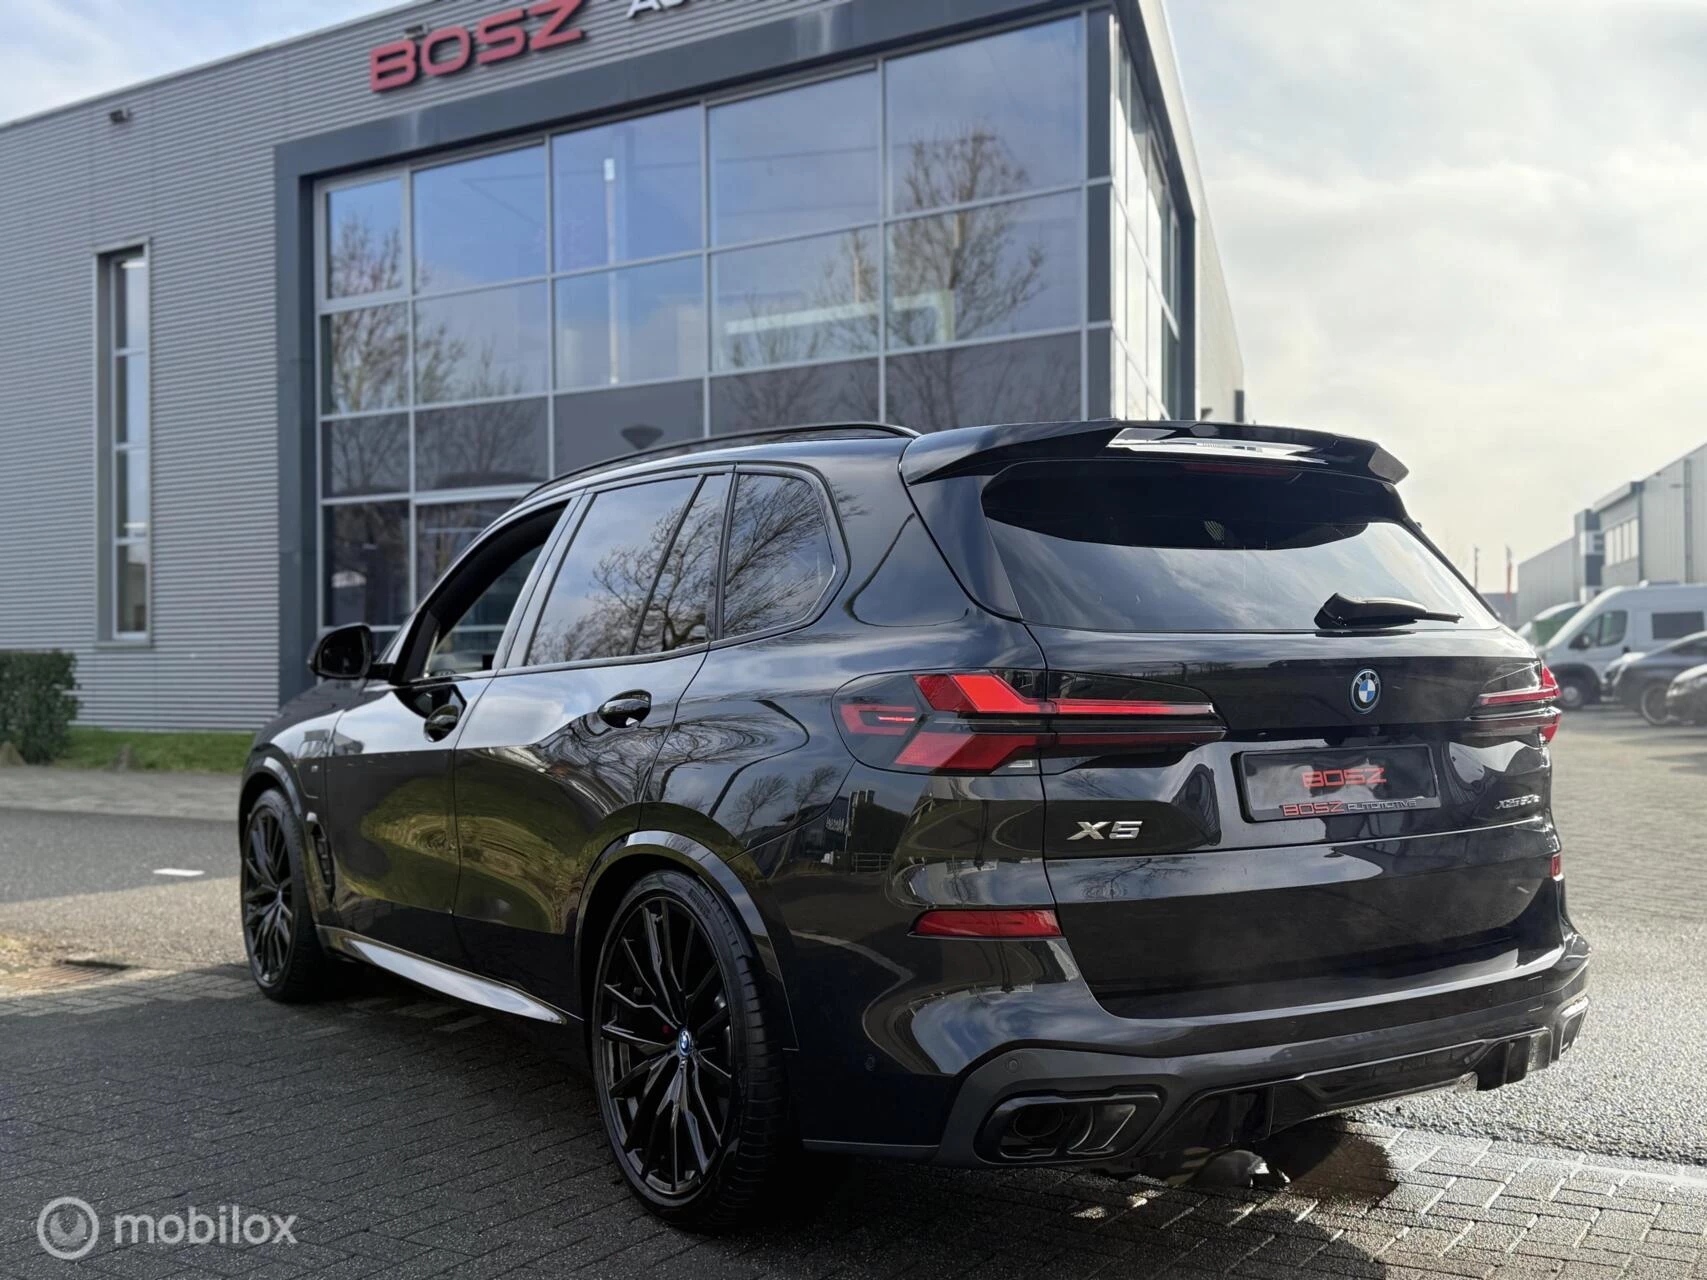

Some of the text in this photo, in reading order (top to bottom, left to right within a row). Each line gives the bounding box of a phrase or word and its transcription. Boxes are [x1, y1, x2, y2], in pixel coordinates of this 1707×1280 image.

[369, 0, 586, 92] BOSZ
[1302, 767, 1387, 789] BOSZ
[1282, 799, 1417, 817] BOSZ AUTOMOTIVE
[1066, 820, 1143, 841] X5
